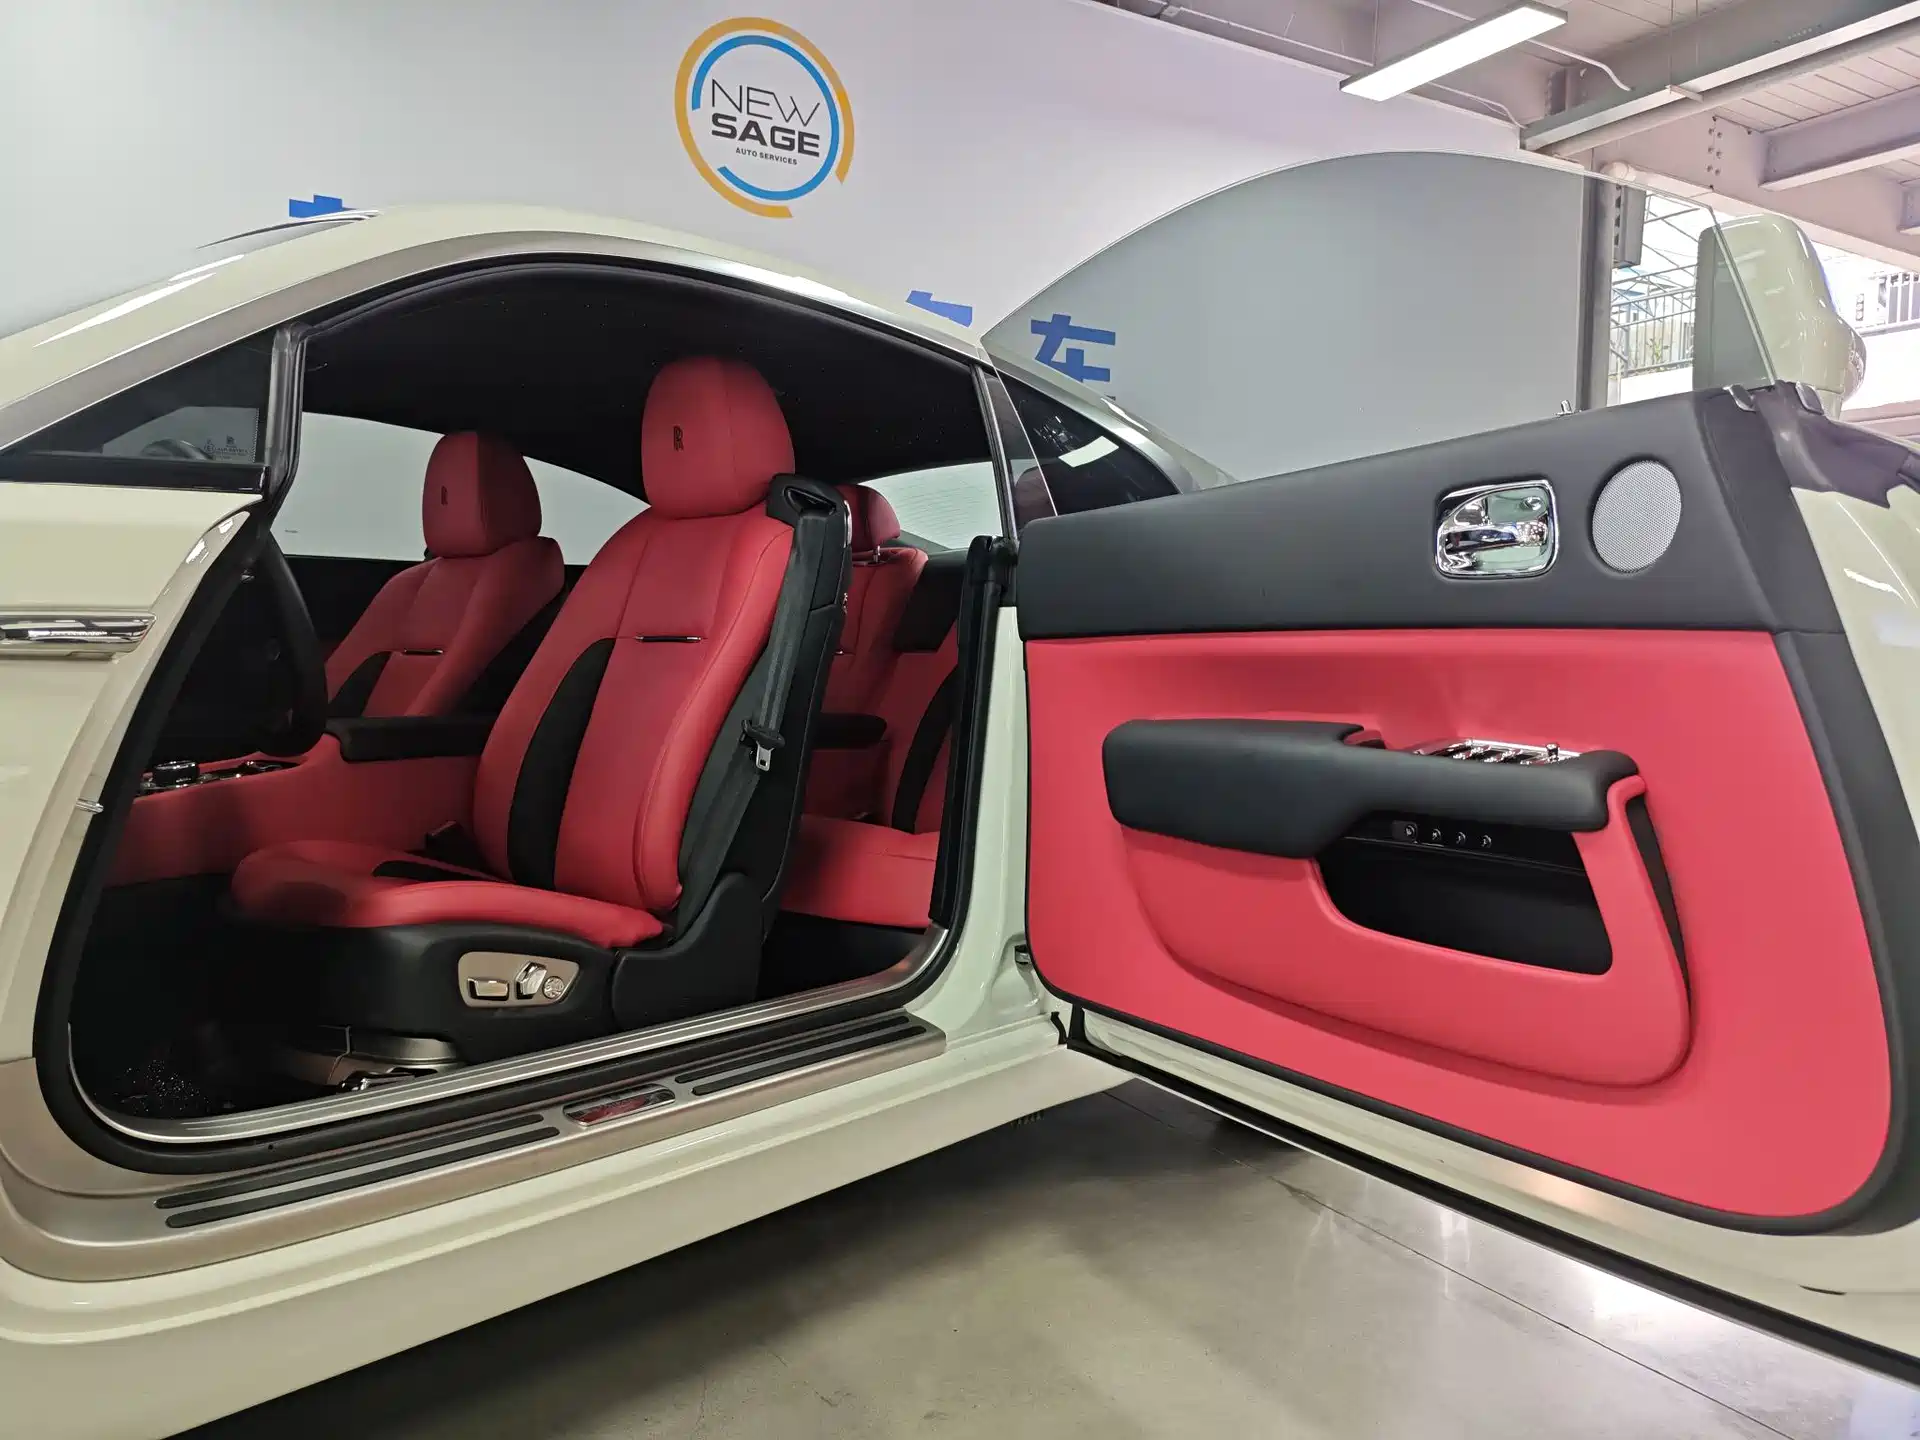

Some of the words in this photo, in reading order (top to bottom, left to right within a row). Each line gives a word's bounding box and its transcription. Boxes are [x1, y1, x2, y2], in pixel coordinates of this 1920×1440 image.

[711, 78, 820, 127] NEW
[711, 112, 819, 158] SAGE
[735, 147, 758, 157] AUTO
[759, 152, 798, 165] SERVICES
